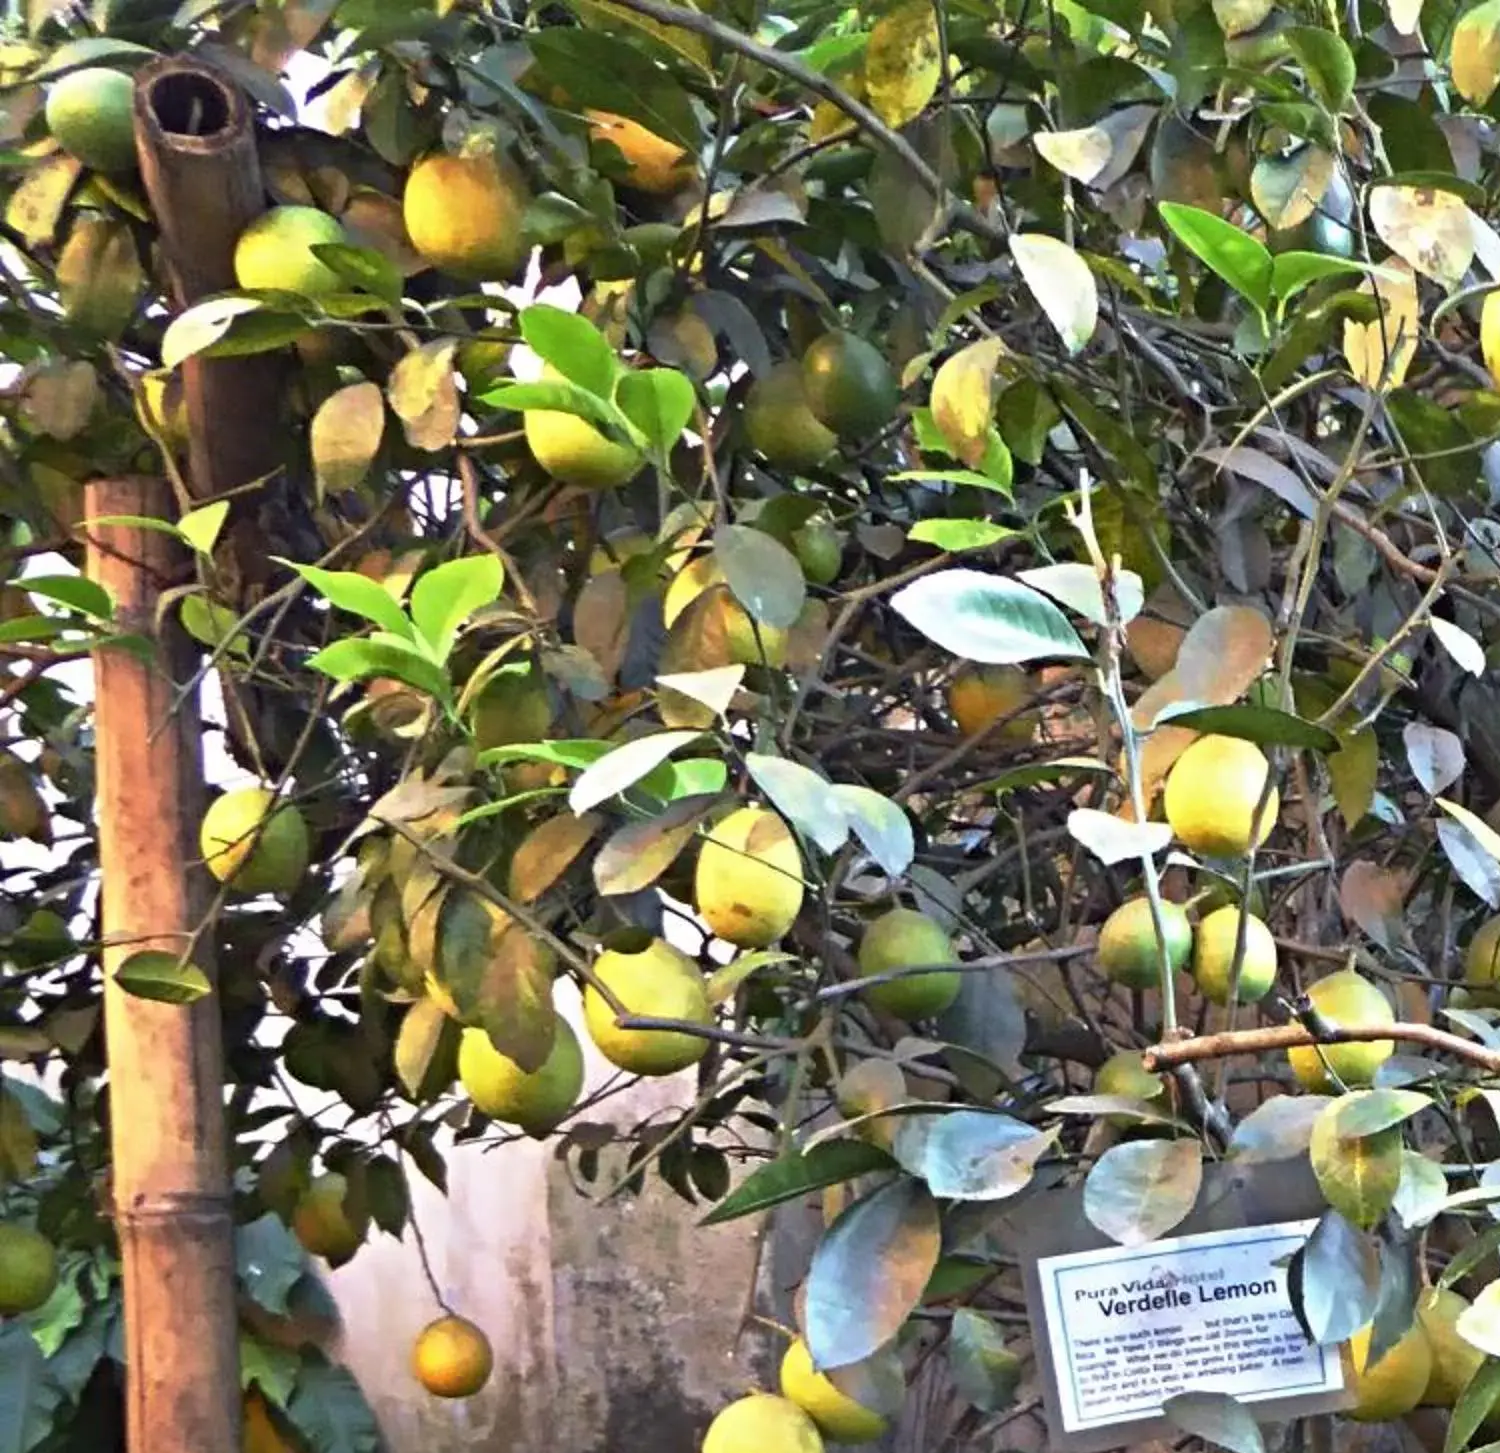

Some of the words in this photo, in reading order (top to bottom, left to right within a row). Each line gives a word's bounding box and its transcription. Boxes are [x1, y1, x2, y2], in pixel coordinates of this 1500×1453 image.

[1075, 1286, 1119, 1301] Pura
[1121, 1278, 1165, 1293] Vida
[1098, 1289, 1192, 1317] Verdelle
[1198, 1279, 1277, 1303] Lemon
